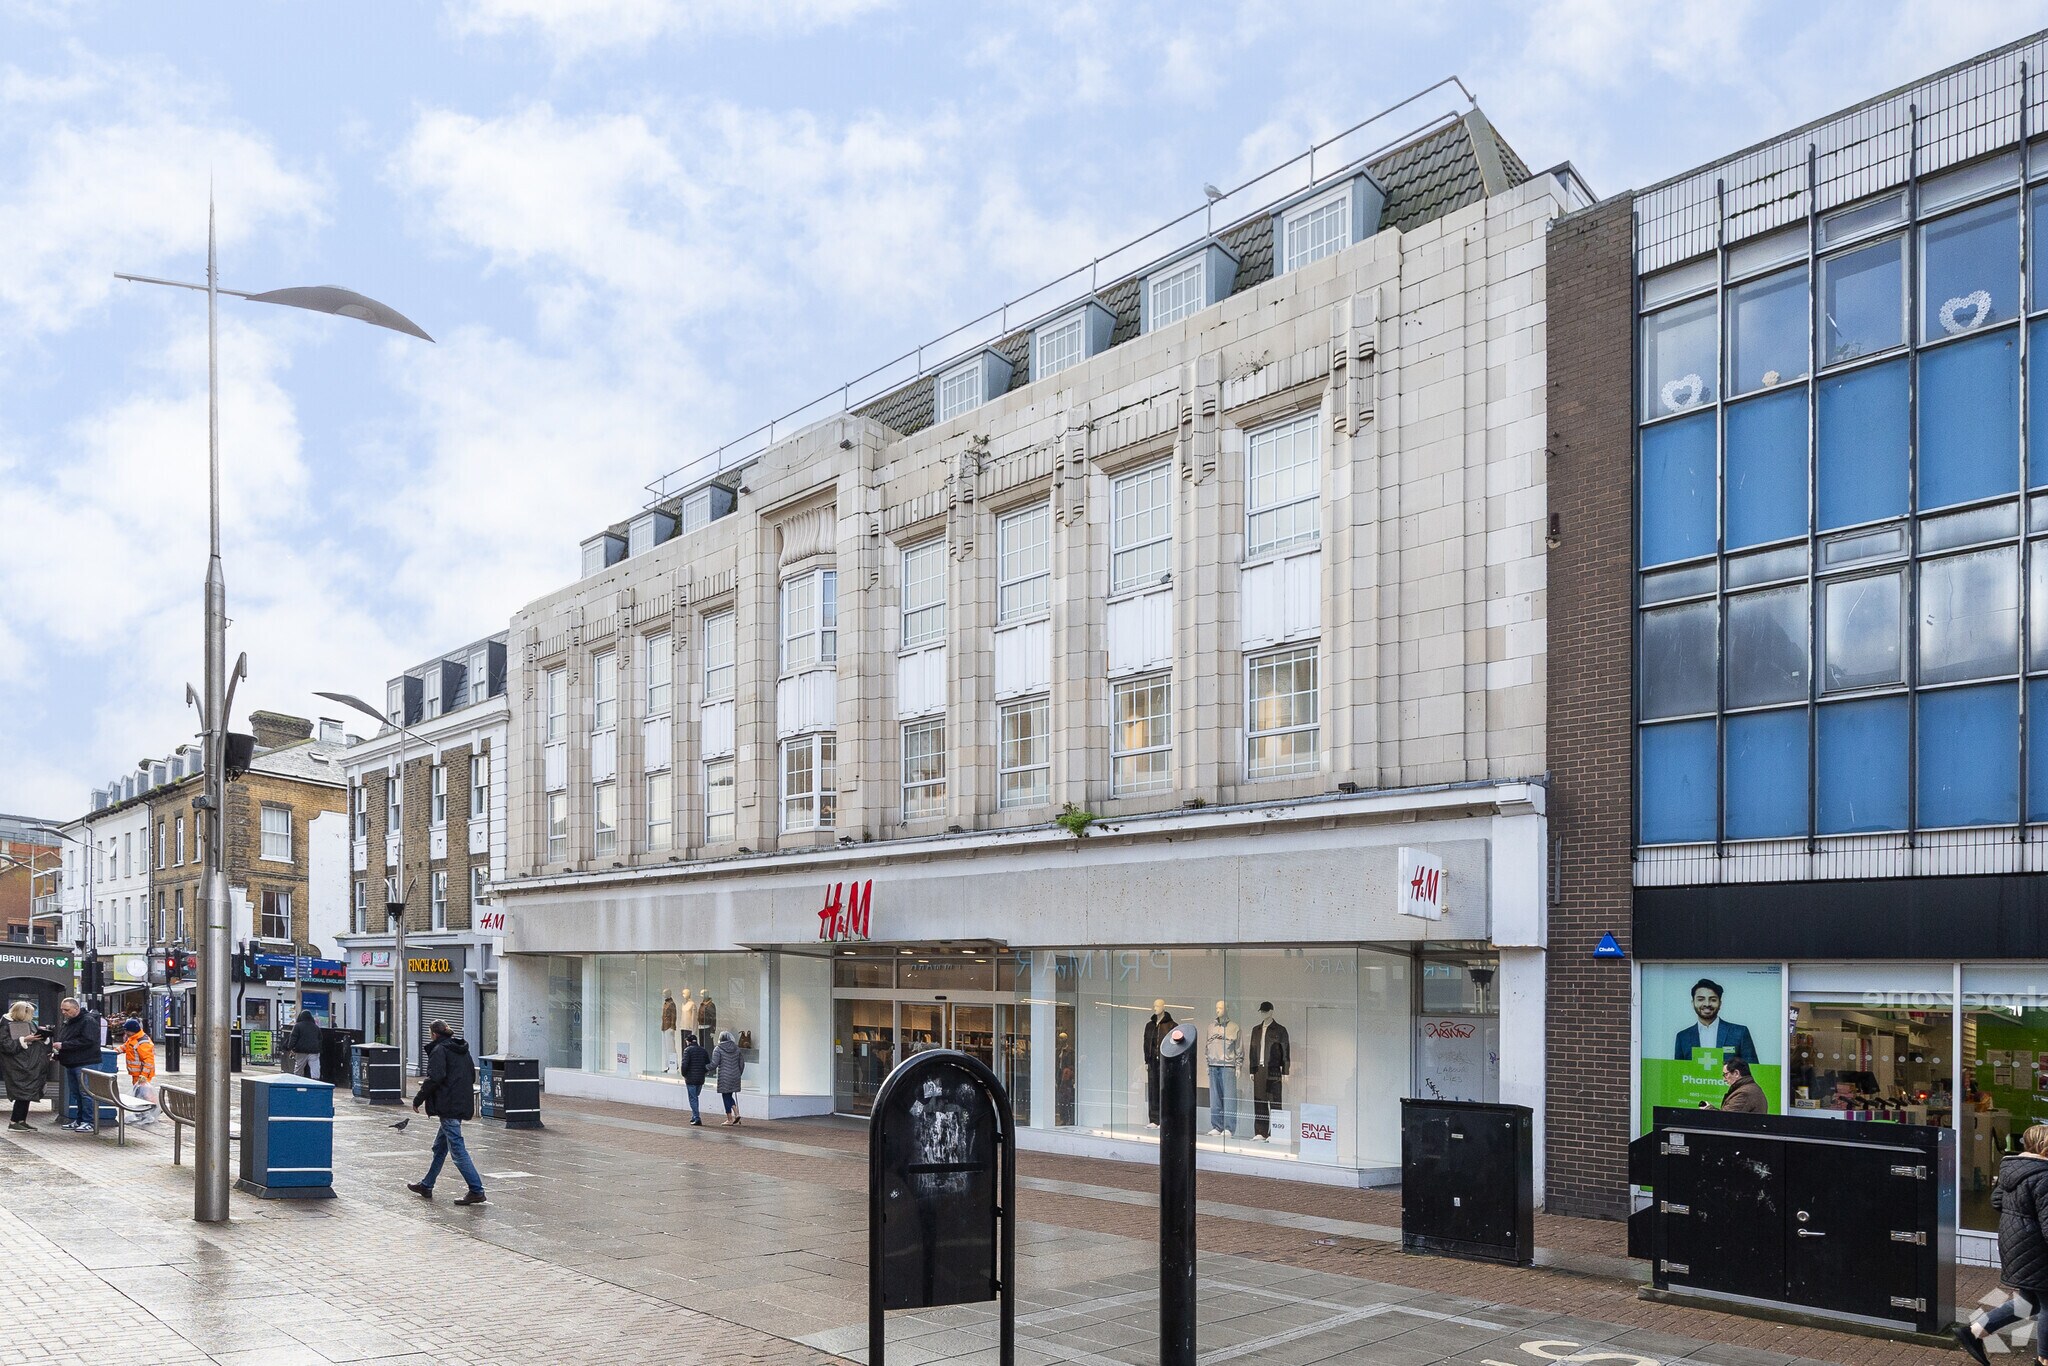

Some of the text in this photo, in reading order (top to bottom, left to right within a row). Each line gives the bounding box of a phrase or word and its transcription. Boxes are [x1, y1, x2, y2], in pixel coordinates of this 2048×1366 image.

[1410, 864, 1440, 906] H&M
[817, 878, 873, 941] H&M
[480, 912, 506, 931] H&M
[407, 957, 450, 972] FINCH & CO.
[1301, 1122, 1335, 1134] FINAL
[1301, 1130, 1332, 1141] SALE
